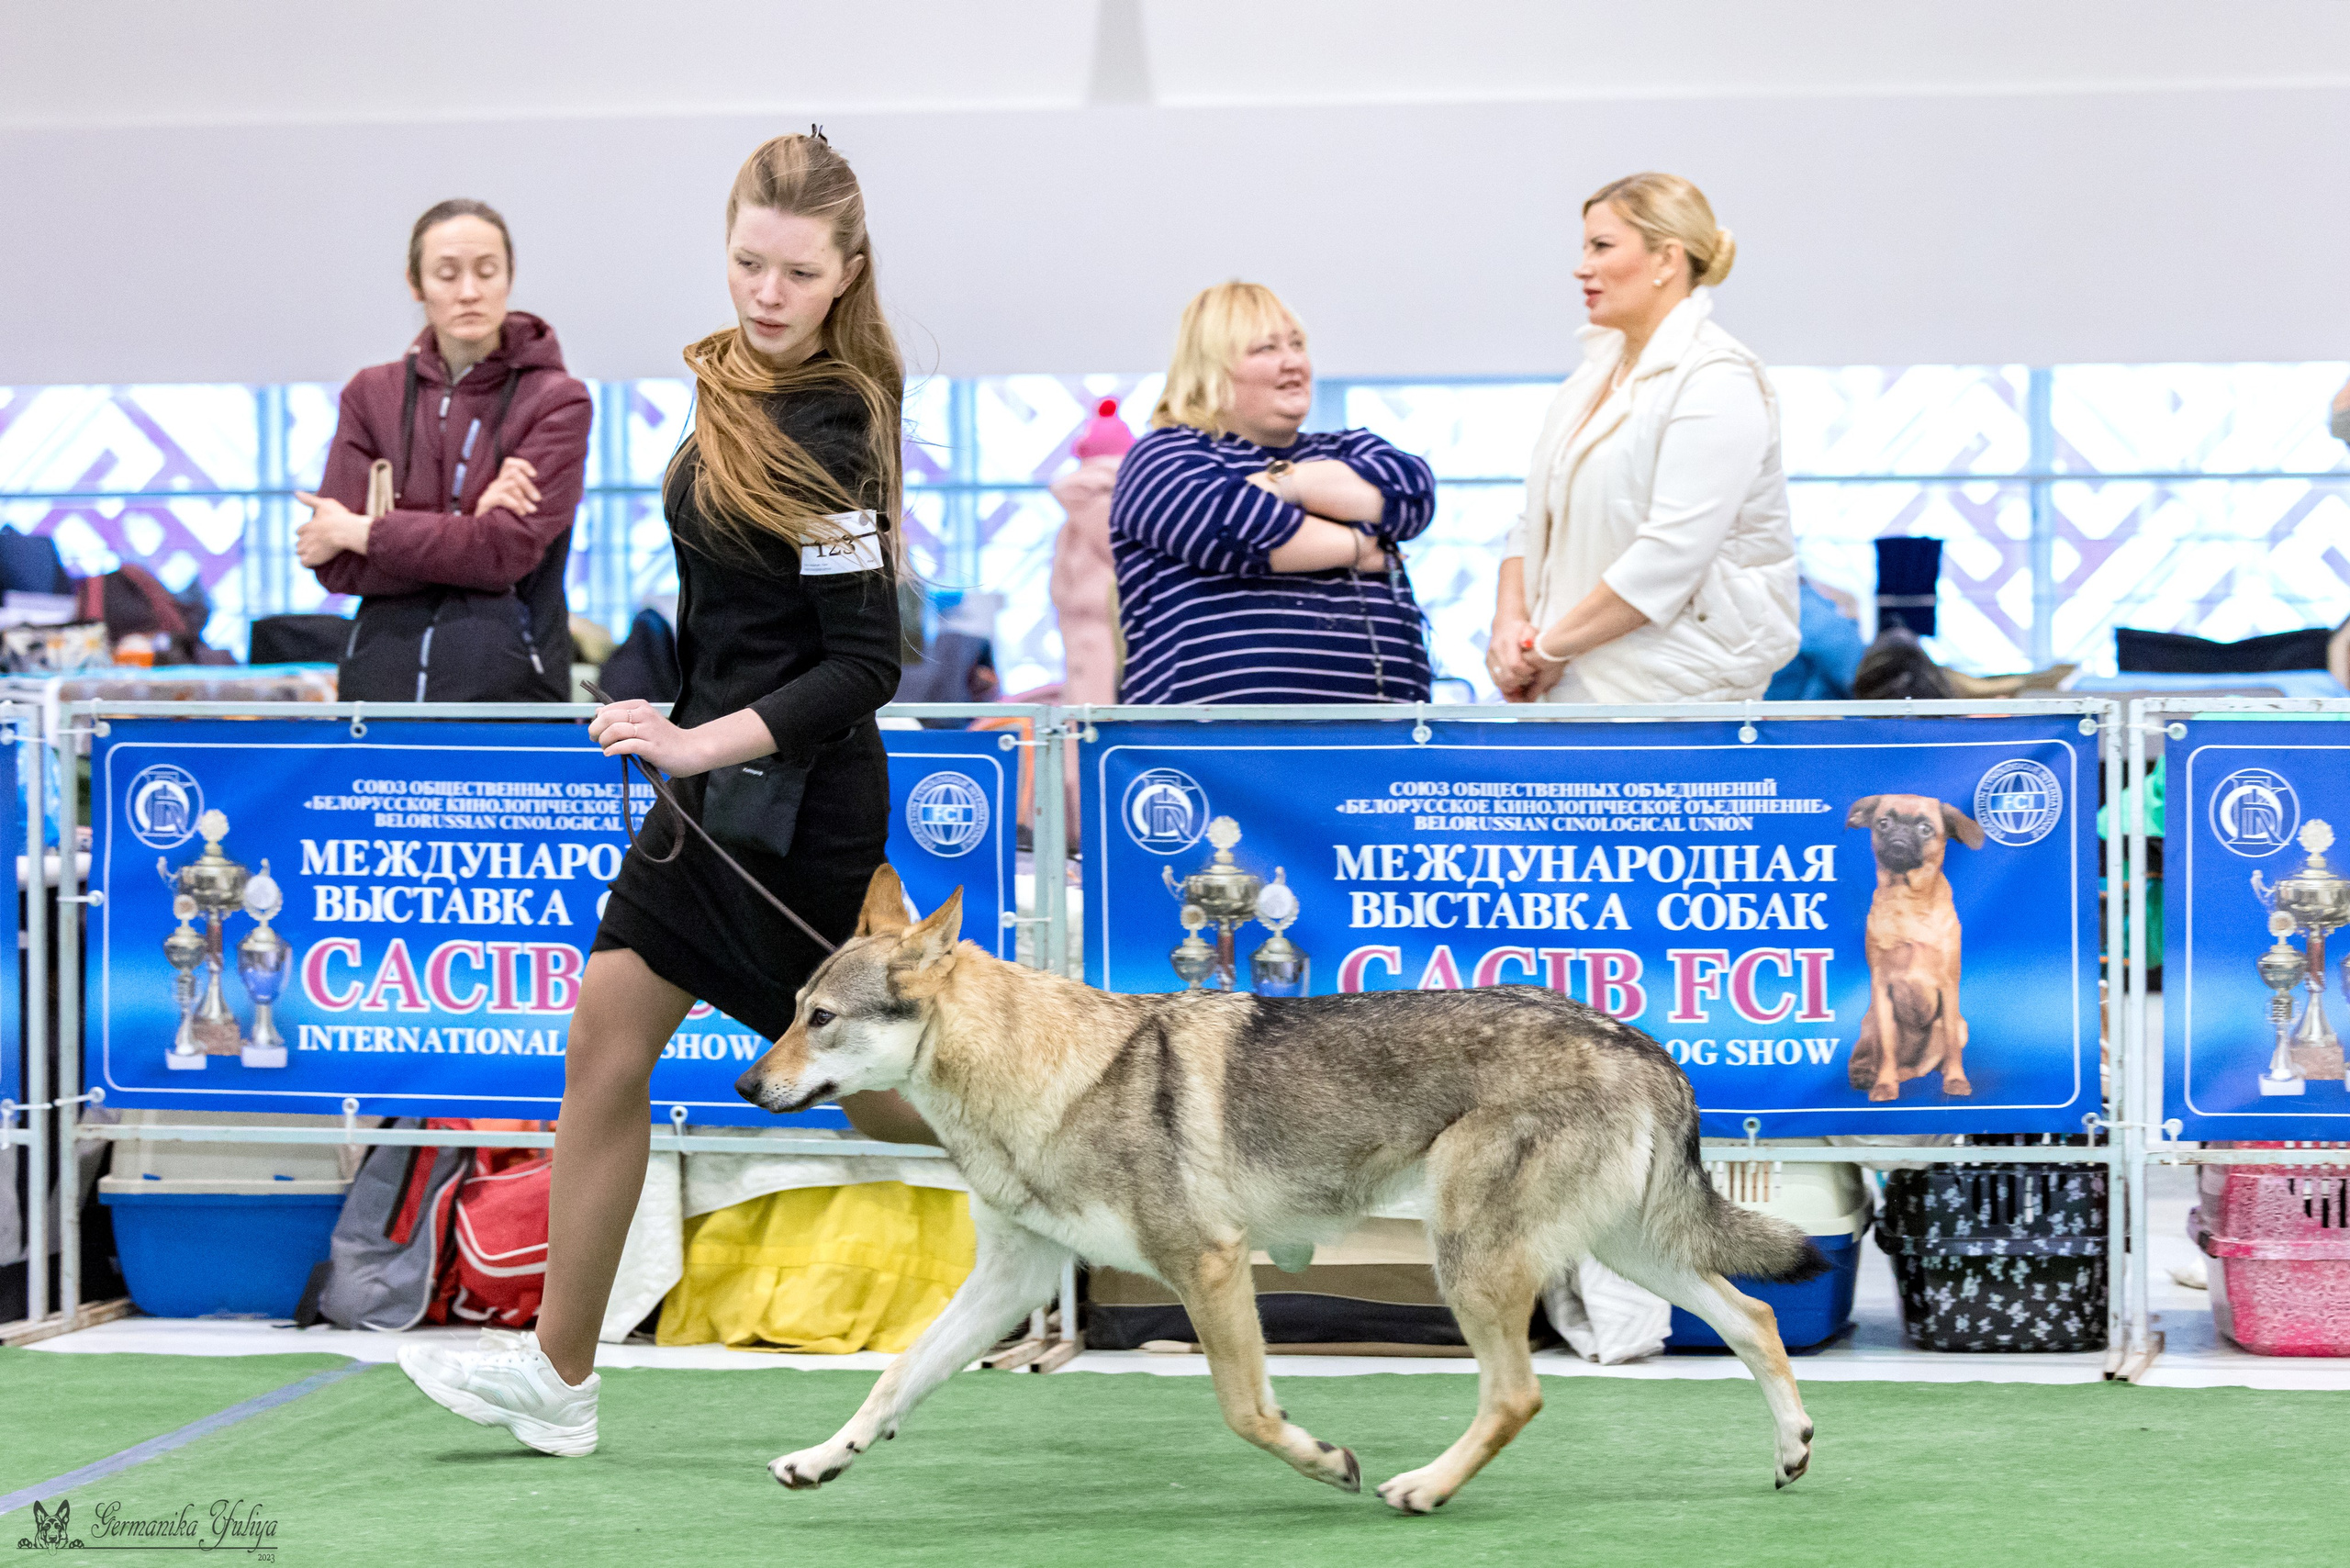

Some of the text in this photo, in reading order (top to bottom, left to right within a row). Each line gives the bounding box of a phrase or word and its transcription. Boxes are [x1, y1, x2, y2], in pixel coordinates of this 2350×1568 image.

[352, 778, 407, 795] СОЮЗ
[408, 779, 564, 798] ОБЩЕСТВЕННЫХ
[1389, 778, 1777, 799] СОЮЗ ОБЩЕСТВЕННЫХ ОБЪЕДИНЕНИЙ
[445, 797, 621, 814] КИНОЛОГИЧЕСКОЕ
[1493, 800, 1682, 815] КИНОЛОГИЧЕСКОЕ
[2002, 794, 2035, 810] FCI
[375, 812, 497, 829] BELORUSSIAN
[498, 814, 624, 832] CINOLOGICAL
[933, 807, 963, 822] FCI
[1414, 815, 1753, 832] BELORUSSIAN CINOLOGICAL UNION
[300, 839, 632, 884] МЕЖДУНАРО
[1334, 845, 1838, 890] МЕЖДУНАРОДНАЯ
[313, 885, 574, 925] ВЫСТАВКА
[1348, 891, 1829, 931] ВЫСТАВКА СОБАК
[301, 936, 585, 1014] CACIB
[1666, 946, 1835, 1025] FCI
[298, 1024, 566, 1056] INTERNATIONAL
[1660, 1038, 1840, 1066] OG SHOW
